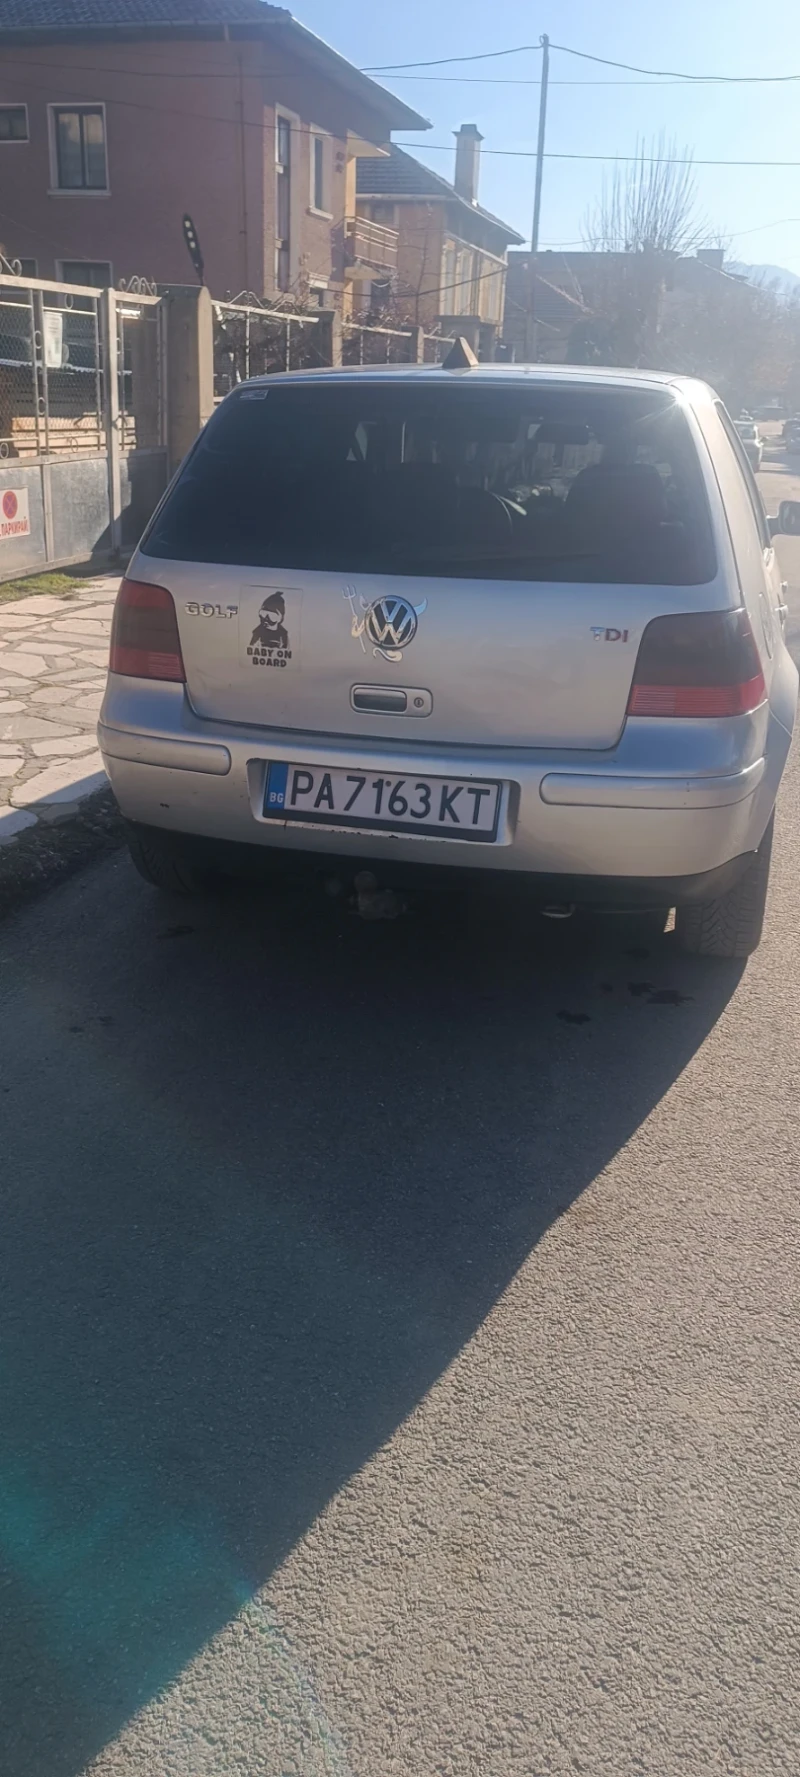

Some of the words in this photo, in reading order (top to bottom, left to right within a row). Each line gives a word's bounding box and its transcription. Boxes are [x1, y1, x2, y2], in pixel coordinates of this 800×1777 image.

[184, 601, 239, 619] GOLF
[589, 626, 629, 643] TDI
[246, 647, 275, 658] BABY
[277, 649, 292, 659] ON
[252, 656, 287, 668] BOARD
[269, 792, 284, 804] BG
